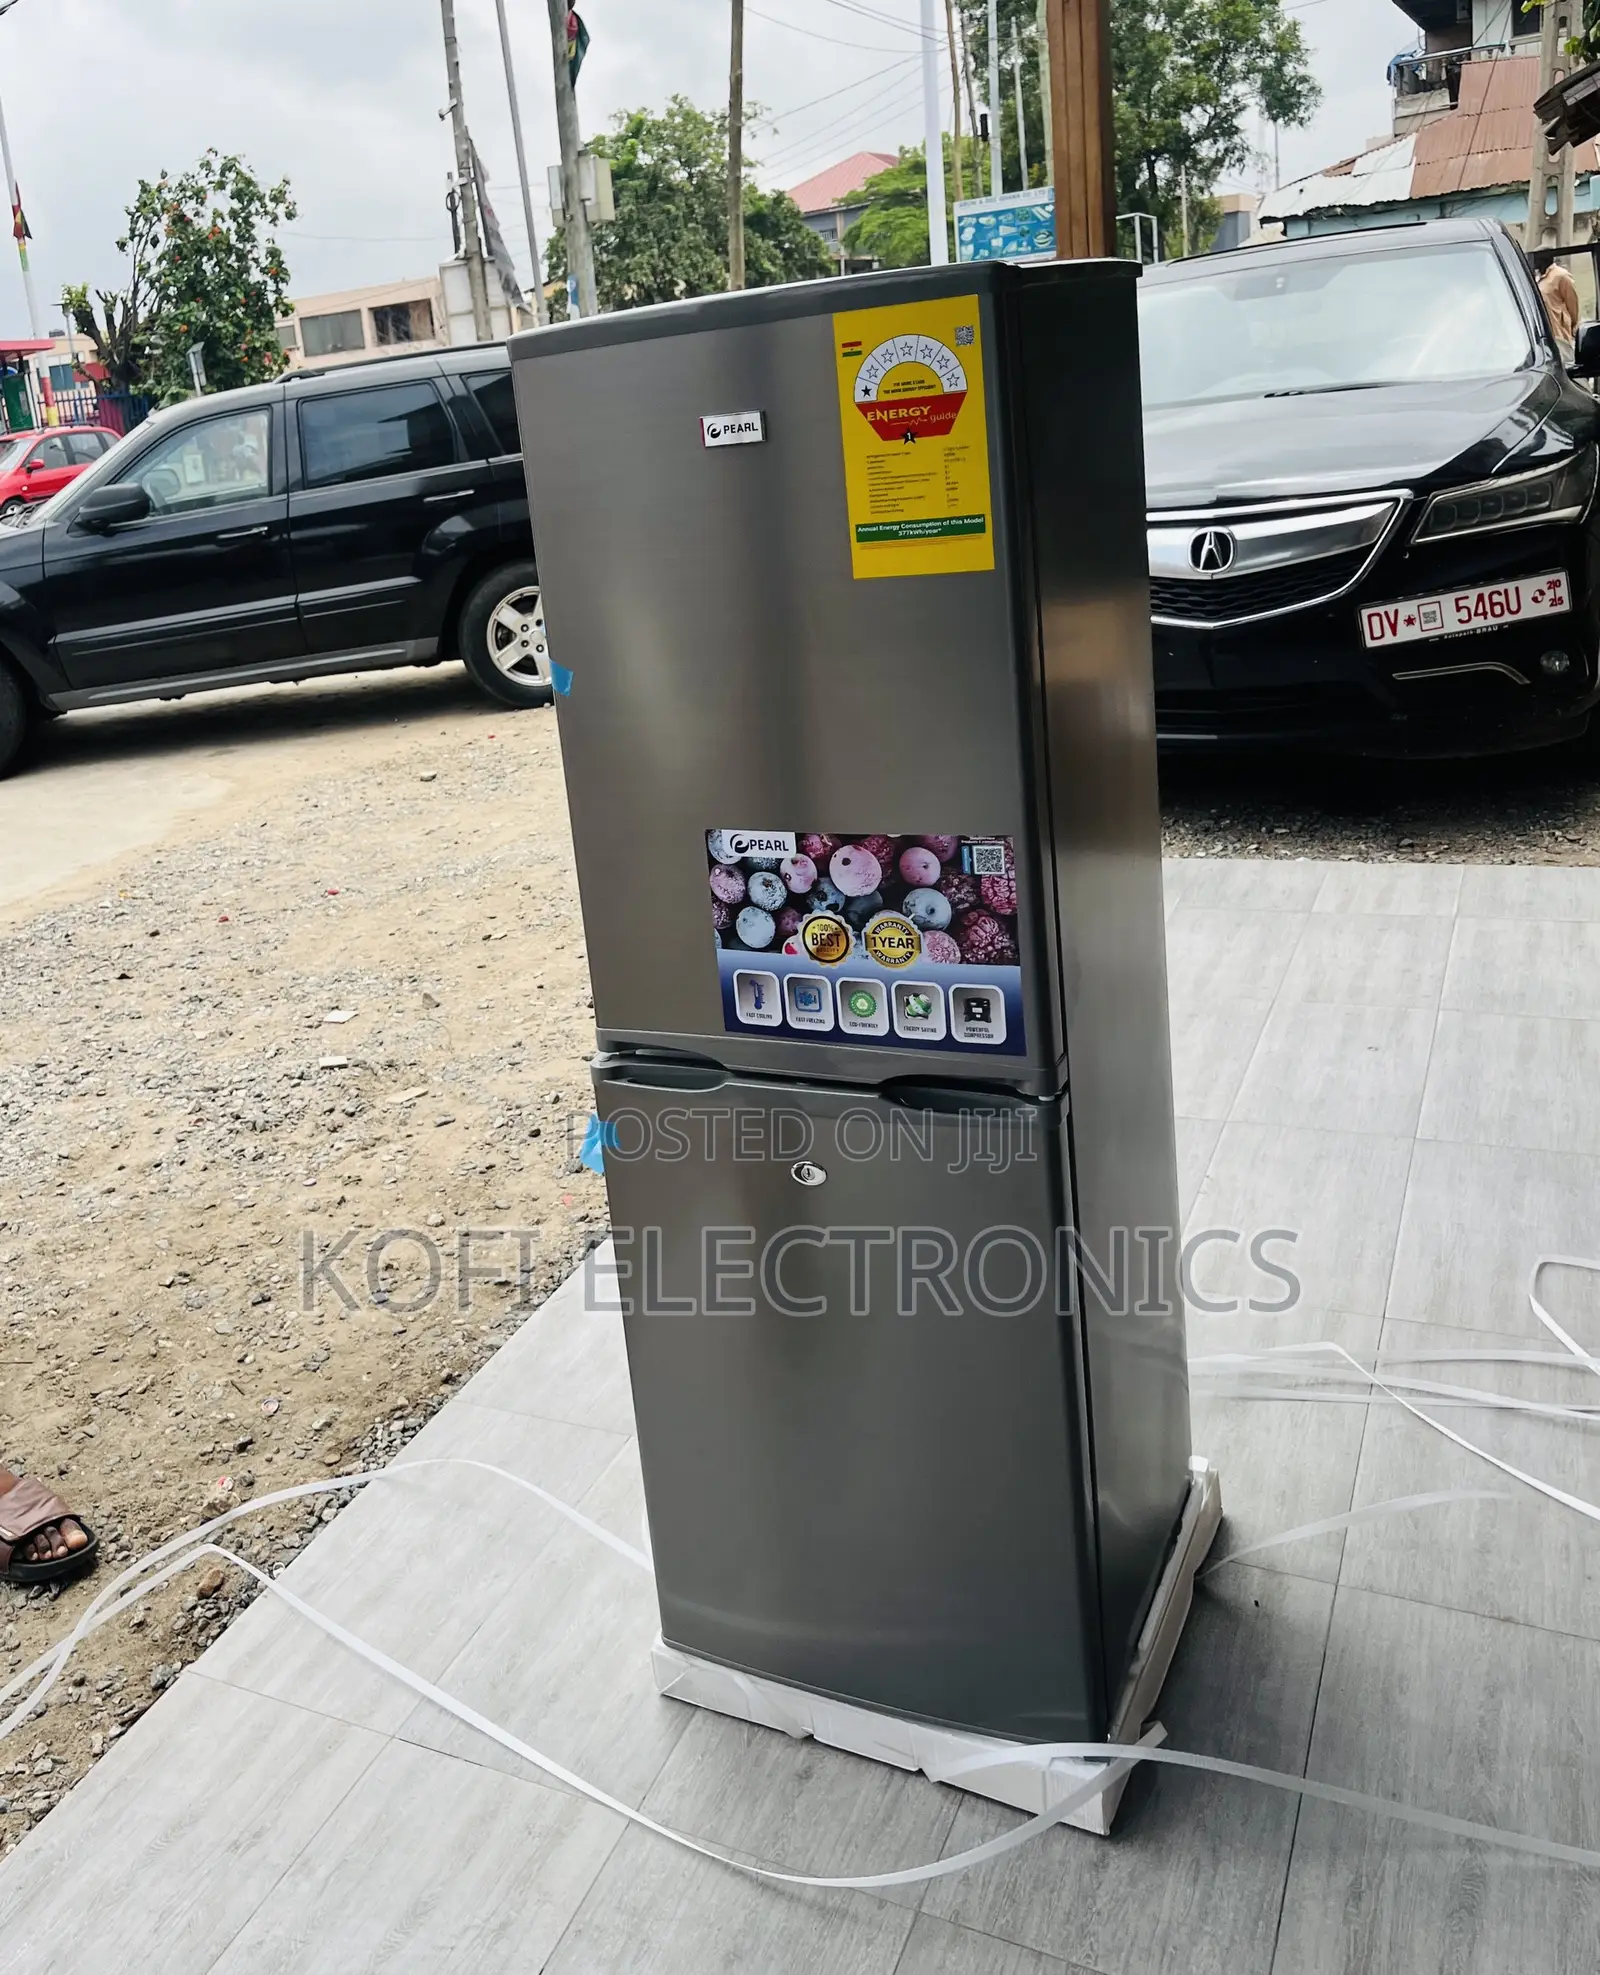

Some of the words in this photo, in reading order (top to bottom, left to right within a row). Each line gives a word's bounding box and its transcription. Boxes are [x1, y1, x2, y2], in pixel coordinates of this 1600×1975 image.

[866, 406, 931, 422] ENERGY
[930, 412, 956, 424] guide
[723, 422, 759, 435] PEARL
[907, 432, 911, 440] 1
[857, 525, 879, 533] Annual
[879, 524, 900, 532] Energy
[900, 520, 942, 530] Consumption
[963, 517, 984, 525] Model
[1367, 608, 1399, 641] DV
[1454, 586, 1522, 625] 546U
[749, 839, 789, 852] PEARL
[817, 923, 834, 933] 100%
[875, 920, 910, 935] WARRANTY
[811, 932, 841, 948] BEST
[870, 937, 878, 948] 1
[879, 936, 915, 950] YEAR
[875, 951, 912, 965] WARRANTY
[964, 1032, 994, 1040] COMPRESSOR
[965, 1026, 990, 1034] POWERFUL
